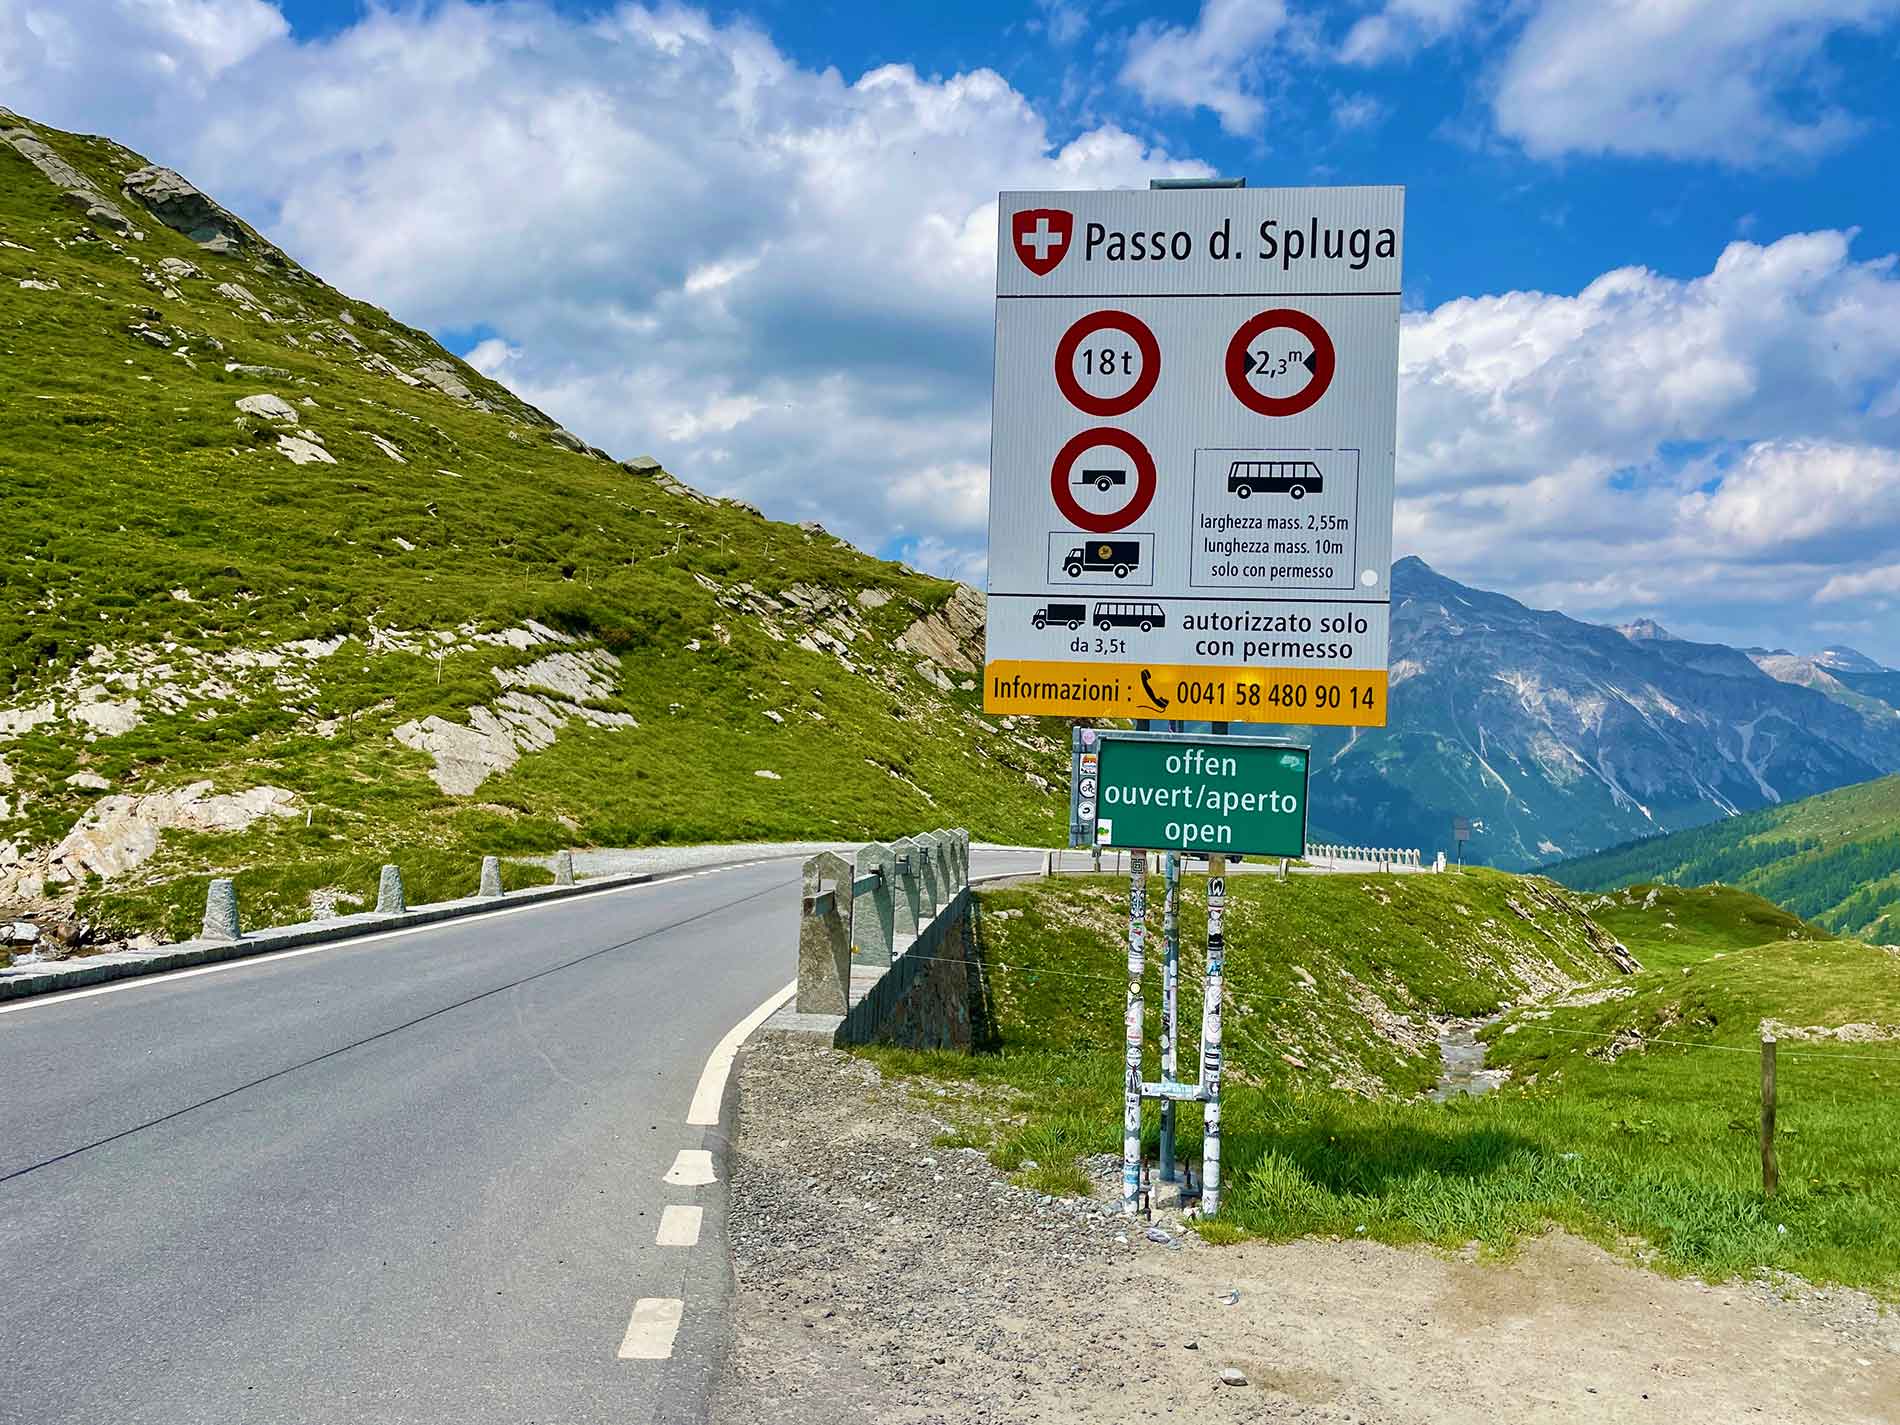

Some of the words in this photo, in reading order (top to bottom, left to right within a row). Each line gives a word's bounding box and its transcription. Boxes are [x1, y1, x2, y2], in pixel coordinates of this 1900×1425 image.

[1085, 222, 1192, 262] Passo
[1209, 218, 1242, 260] d.
[1259, 216, 1396, 271] Spluga
[1200, 512, 1263, 533] larghezza
[1267, 518, 1303, 530] mass.
[1307, 514, 1349, 532] 2,55m
[1204, 536, 1270, 557] lunghezza
[1273, 542, 1310, 554] mass.
[1315, 539, 1343, 555] 10m
[1211, 560, 1239, 577] solo
[1242, 565, 1266, 578] con
[1270, 566, 1334, 582] permesso
[1182, 610, 1312, 633] autorizzato
[1320, 611, 1368, 634] solo
[1070, 636, 1089, 653] da
[1094, 638, 1126, 656] 3,5t
[1195, 640, 1234, 657] con
[1243, 641, 1353, 663] permesso
[1177, 680, 1225, 705] 0041
[1235, 682, 1261, 707] 58
[1267, 683, 1307, 708] 480
[1315, 684, 1341, 709] 90
[1350, 686, 1375, 710] 14
[1165, 748, 1237, 777] offen
[1104, 784, 1297, 817] ouvert/aperto
[1165, 822, 1232, 848] open
